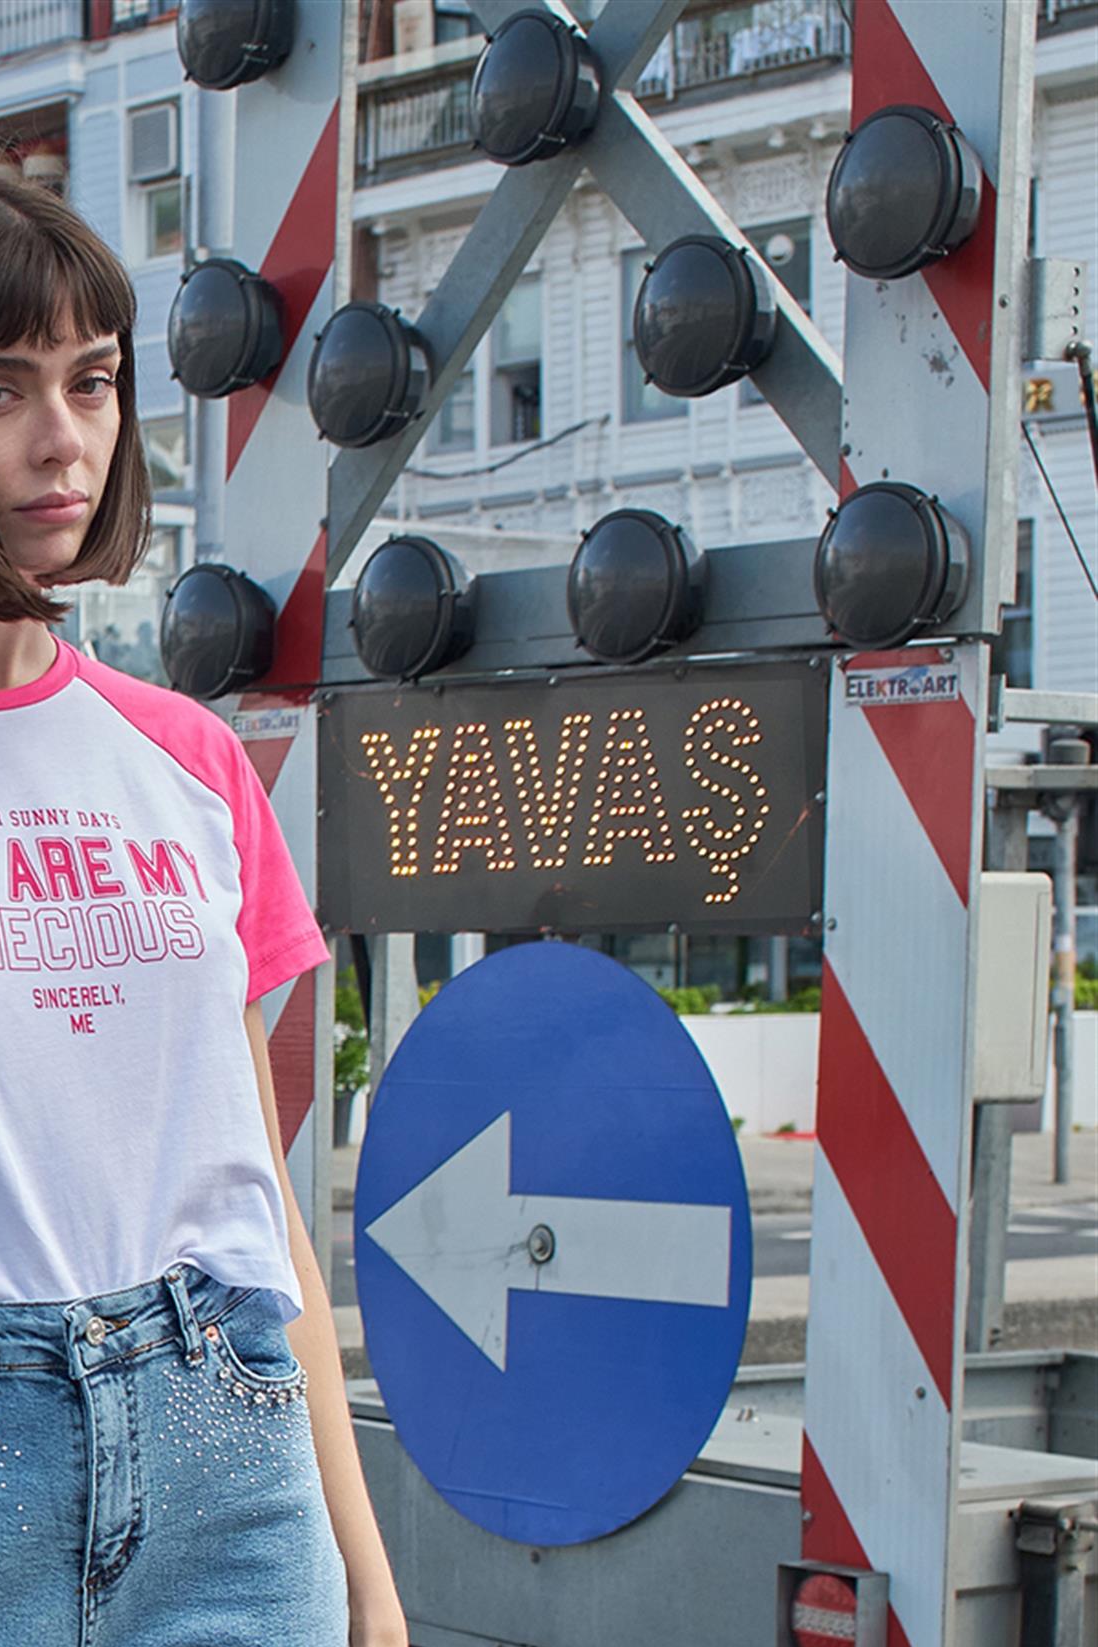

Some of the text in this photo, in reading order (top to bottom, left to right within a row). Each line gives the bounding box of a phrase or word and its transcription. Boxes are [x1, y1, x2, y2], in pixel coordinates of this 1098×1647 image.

[360, 697, 771, 904] YAVAŞ
[9, 809, 70, 827] SUNNY
[78, 812, 122, 830] DAYS
[6, 836, 125, 901] ARE
[123, 838, 209, 903] MY
[32, 984, 125, 1009] SINCERELY,
[69, 1013, 96, 1034] ME
